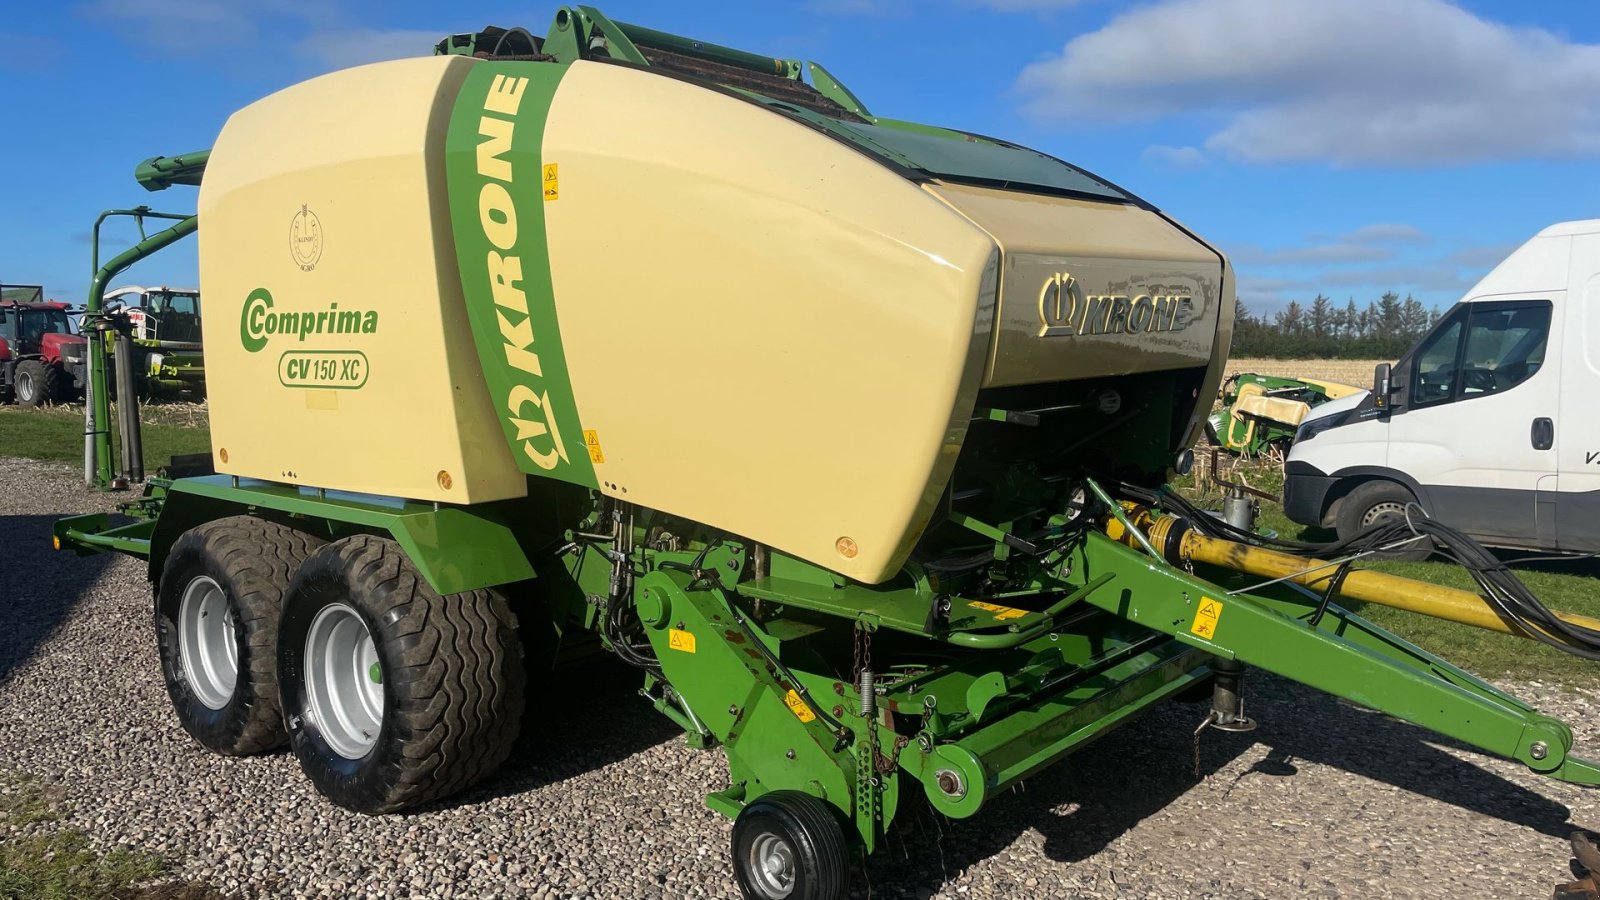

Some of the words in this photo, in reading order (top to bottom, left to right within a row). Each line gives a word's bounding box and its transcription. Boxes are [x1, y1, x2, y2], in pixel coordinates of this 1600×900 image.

[476, 73, 543, 377] KRONE
[1077, 294, 1194, 336] KRONE
[287, 358, 311, 380] CV
[313, 359, 337, 380] 150
[340, 359, 360, 381] XC
